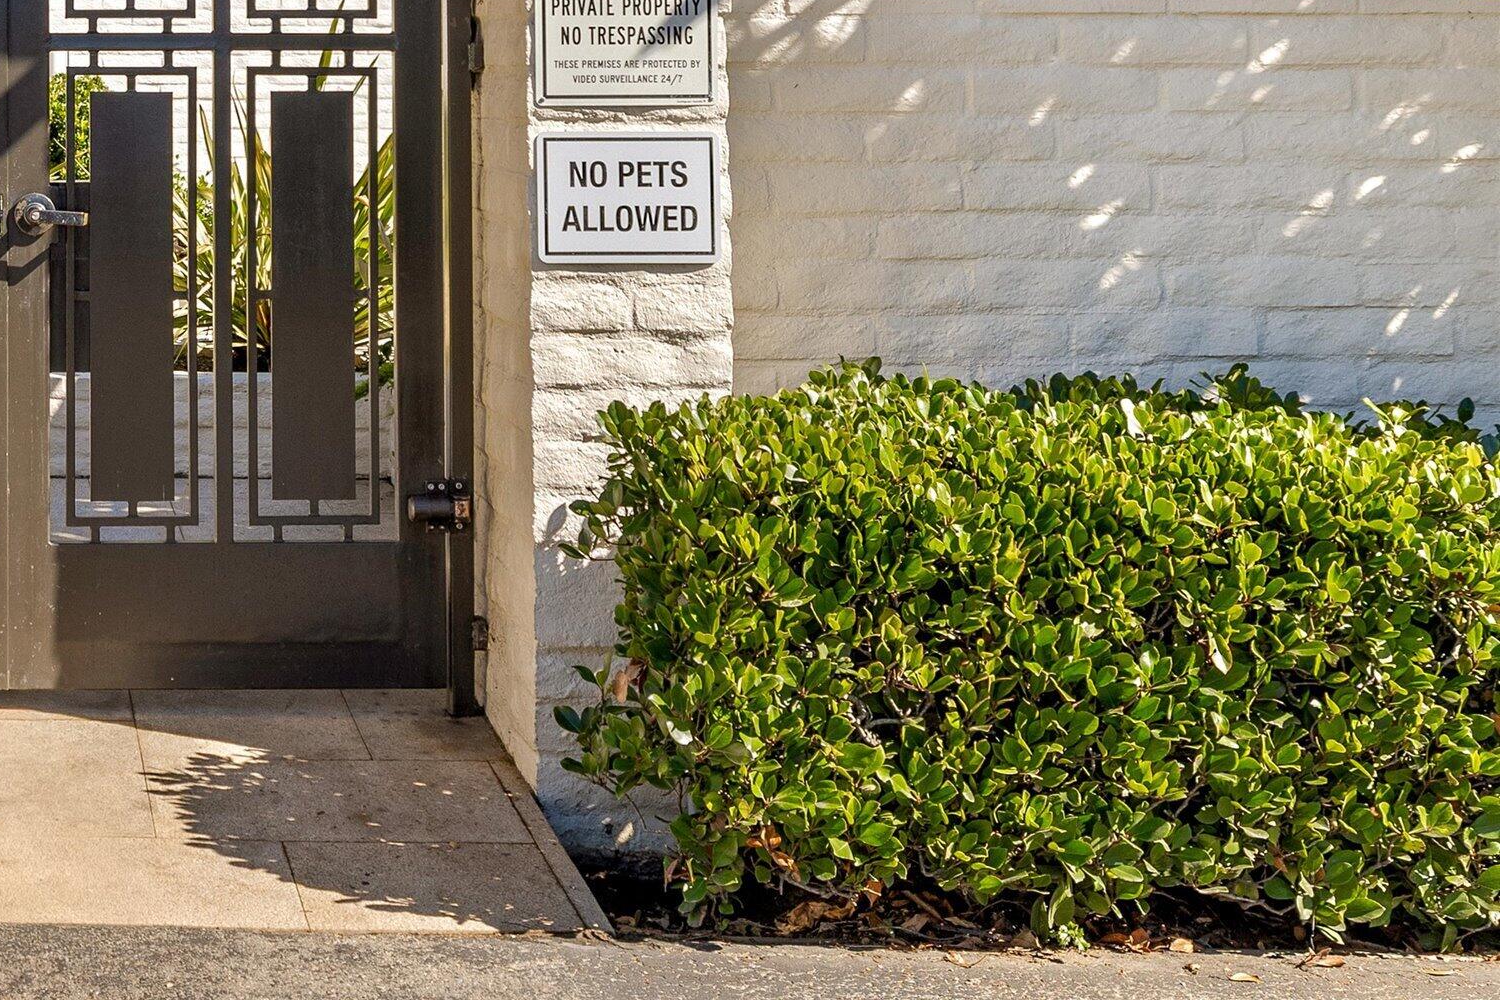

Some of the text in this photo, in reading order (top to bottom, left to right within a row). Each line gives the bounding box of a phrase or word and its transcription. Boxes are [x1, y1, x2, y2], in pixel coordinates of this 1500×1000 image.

[561, 26, 693, 45] NO TRESPASSING
[554, 60, 701, 68] THESE PREMISES ARE PROTECTED BY
[572, 74, 683, 85] VIDEO SURVEILLANCE 24/7
[569, 161, 688, 187] NO PETS
[562, 205, 698, 232] ALLOWED
